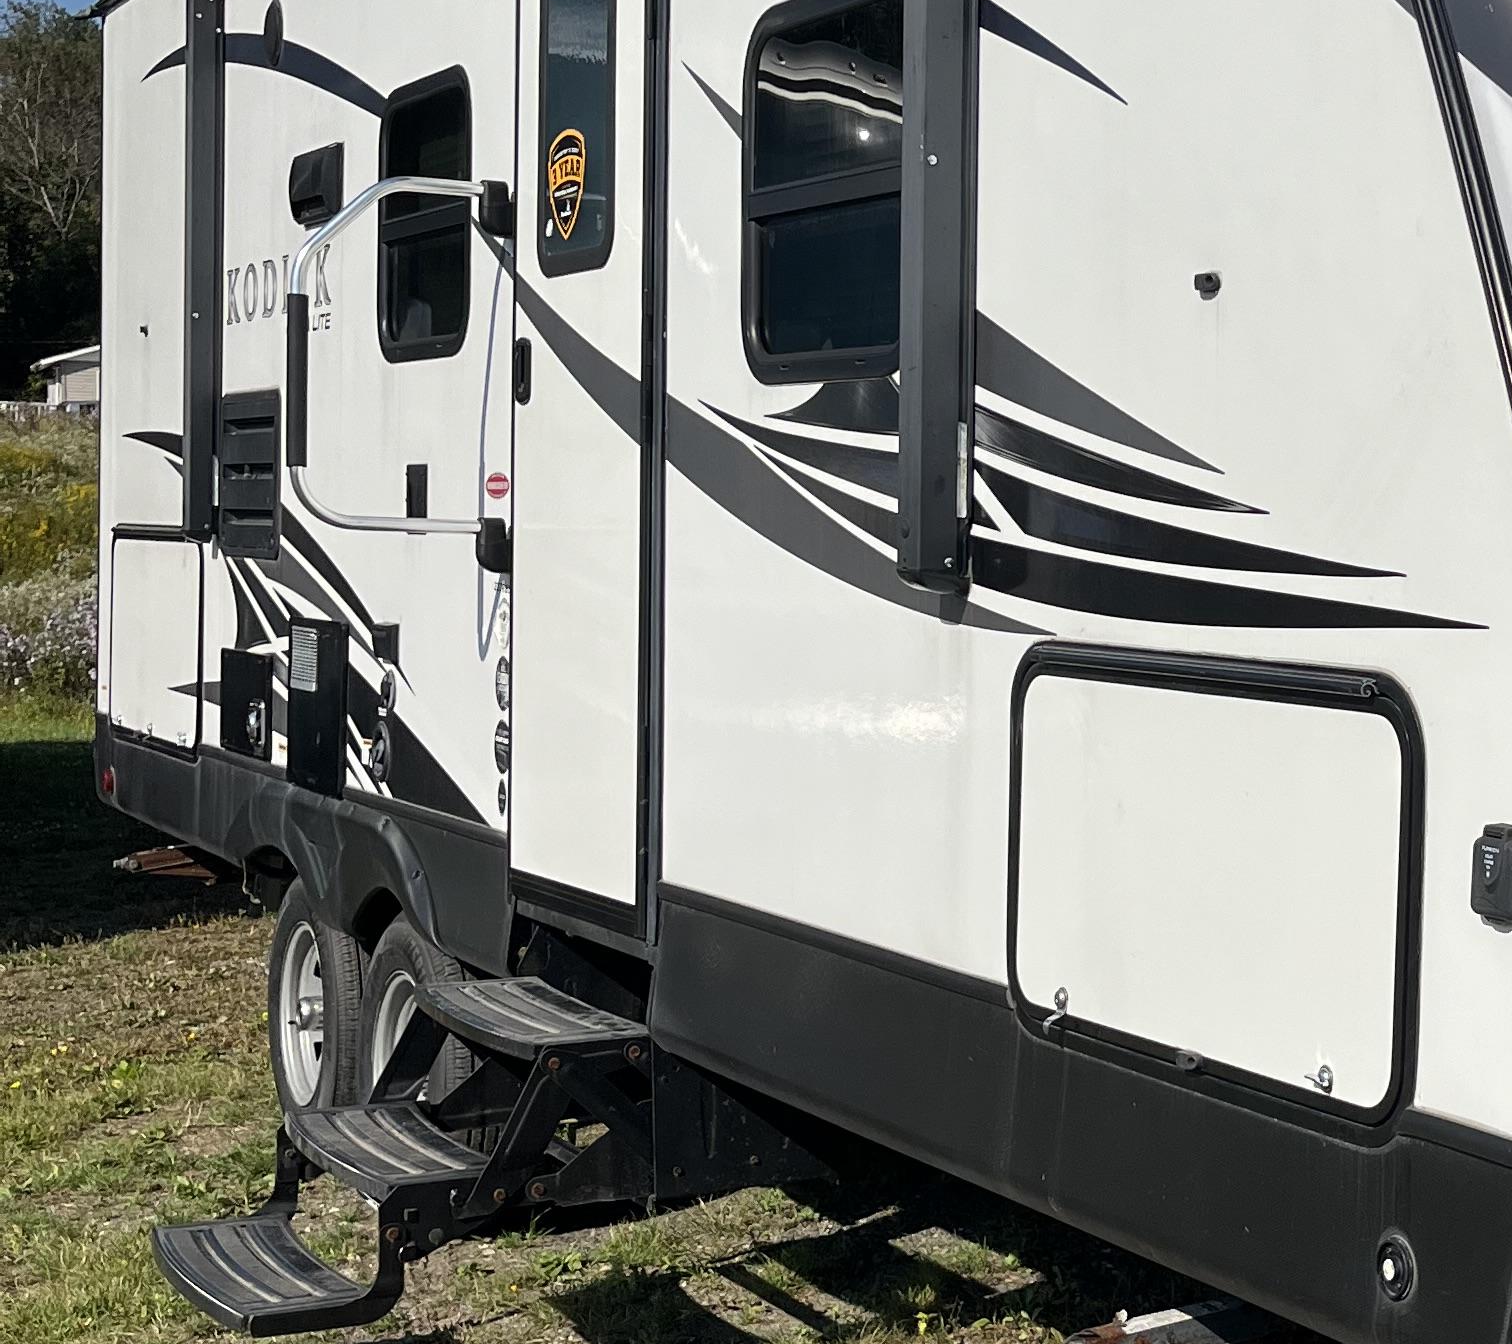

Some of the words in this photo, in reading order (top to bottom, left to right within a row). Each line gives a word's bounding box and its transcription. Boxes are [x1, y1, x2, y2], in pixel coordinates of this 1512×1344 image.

[552, 167, 557, 185] 3
[558, 158, 581, 180] YEAR
[226, 243, 332, 325] KODIK
